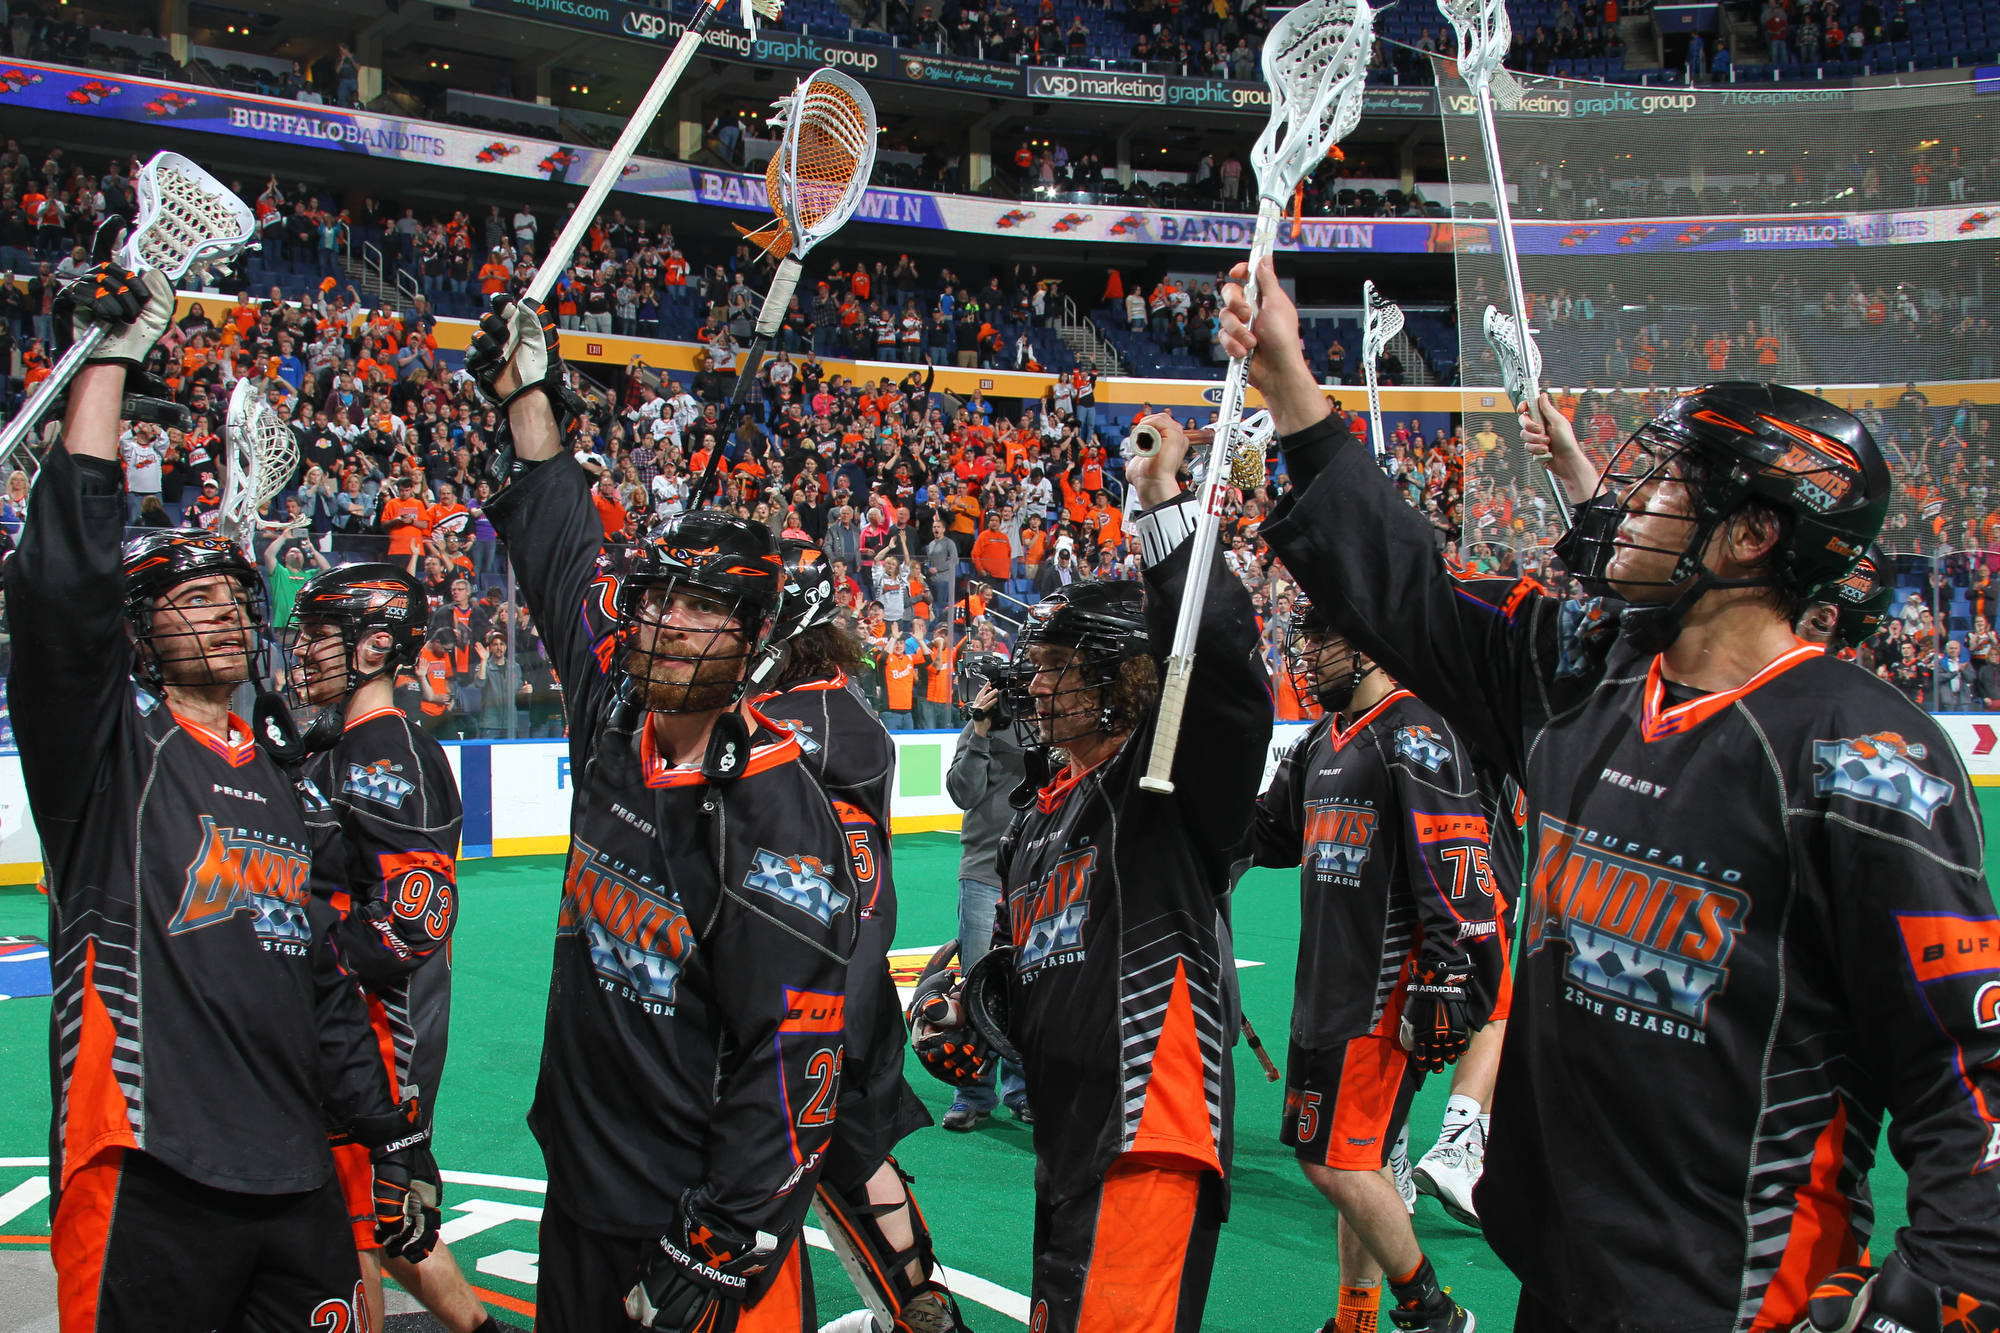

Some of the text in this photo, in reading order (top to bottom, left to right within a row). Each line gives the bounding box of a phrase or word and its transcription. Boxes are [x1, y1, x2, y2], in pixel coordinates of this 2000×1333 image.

[513, 0, 609, 21] aphics.com
[669, 21, 751, 56] mketing
[756, 39, 822, 62] graphic
[824, 48, 878, 72] group
[1042, 75, 1272, 108] vsp marketing graphic grou
[1574, 91, 1640, 118] graphic
[1642, 93, 1696, 114] group
[1160, 216, 1375, 249] BANDS WIN
[1600, 768, 1668, 799] PROJOY
[1440, 845, 1494, 899] 75
[1584, 830, 1743, 883] BUFFALO
[599, 853, 681, 902] BUFFAL
[1528, 812, 1752, 967] BANDITS
[392, 870, 453, 940] 93
[1454, 920, 1497, 943] BANDITS
[621, 985, 676, 1017] SESON
[1418, 985, 1462, 994] ARMOUR
[1563, 987, 1707, 1045] 25TH SEASON
[659, 1235, 747, 1288] UNDER ARMOUR
